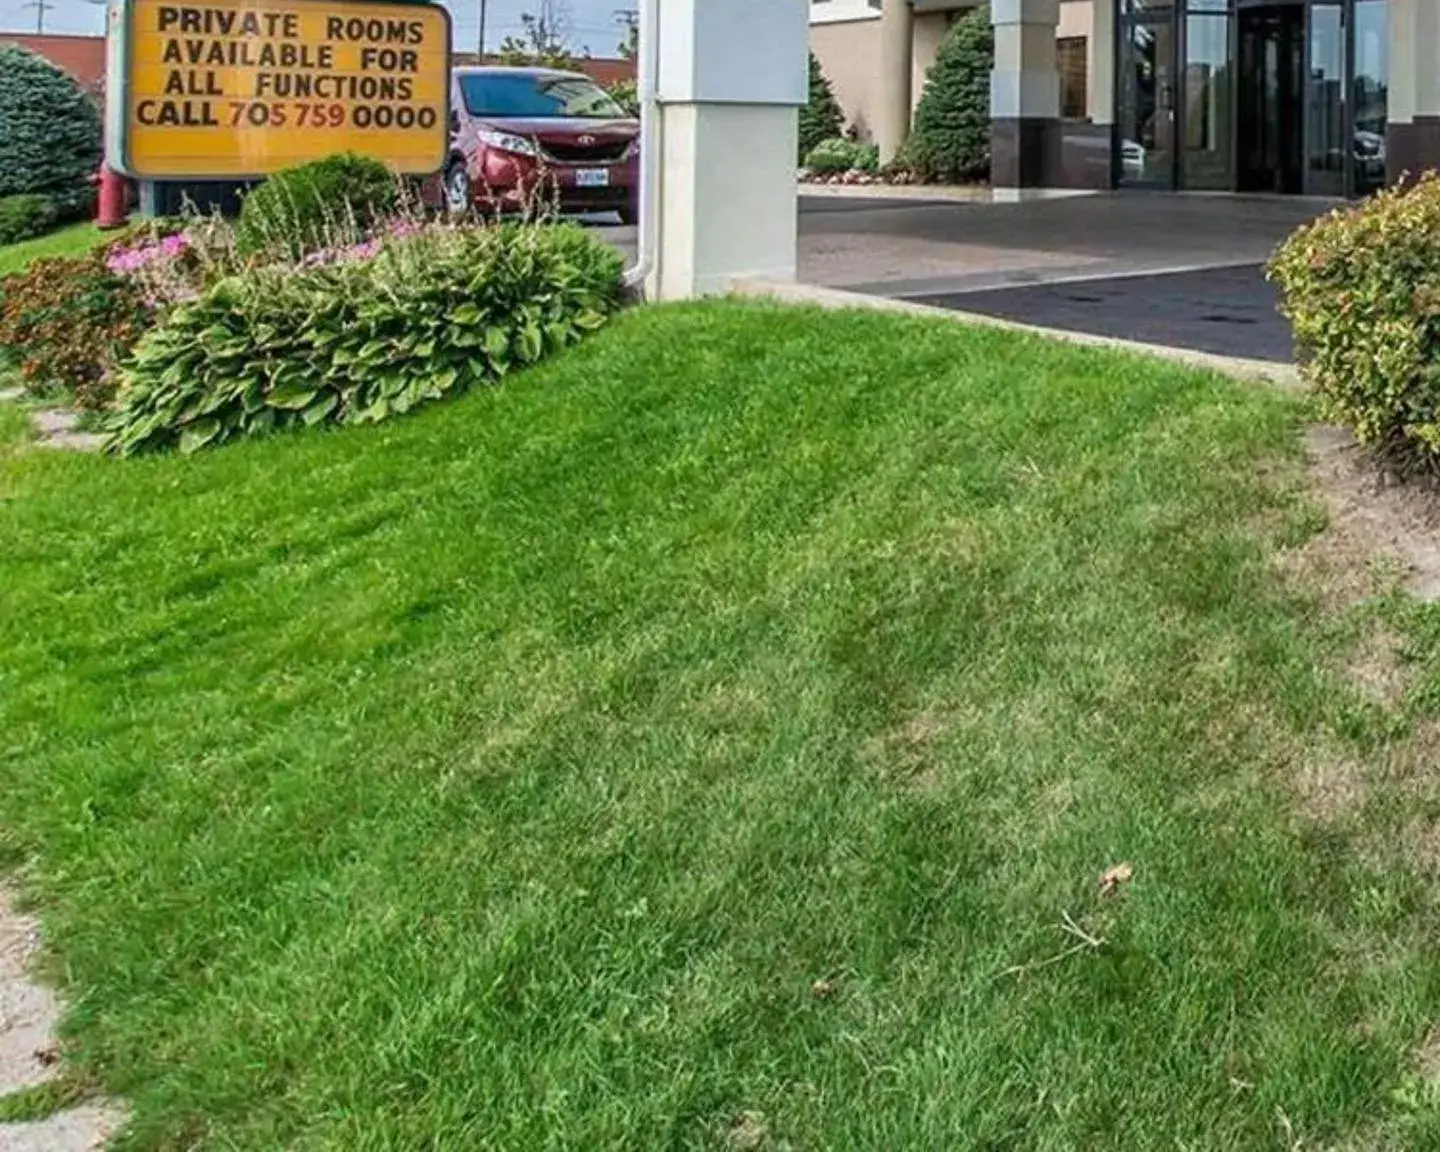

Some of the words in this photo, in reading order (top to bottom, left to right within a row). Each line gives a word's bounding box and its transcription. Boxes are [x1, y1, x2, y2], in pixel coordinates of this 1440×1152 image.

[157, 6, 298, 38] PRIVATE
[327, 16, 423, 44] ROOMS
[163, 39, 333, 68] AVAILABLE
[361, 48, 419, 73] FOR
[165, 70, 223, 96] ALL
[256, 73, 413, 100] FUNCTIONS
[136, 100, 219, 127] CALL
[229, 102, 287, 127] 705
[295, 104, 345, 128] 759
[352, 105, 437, 129] 0000
